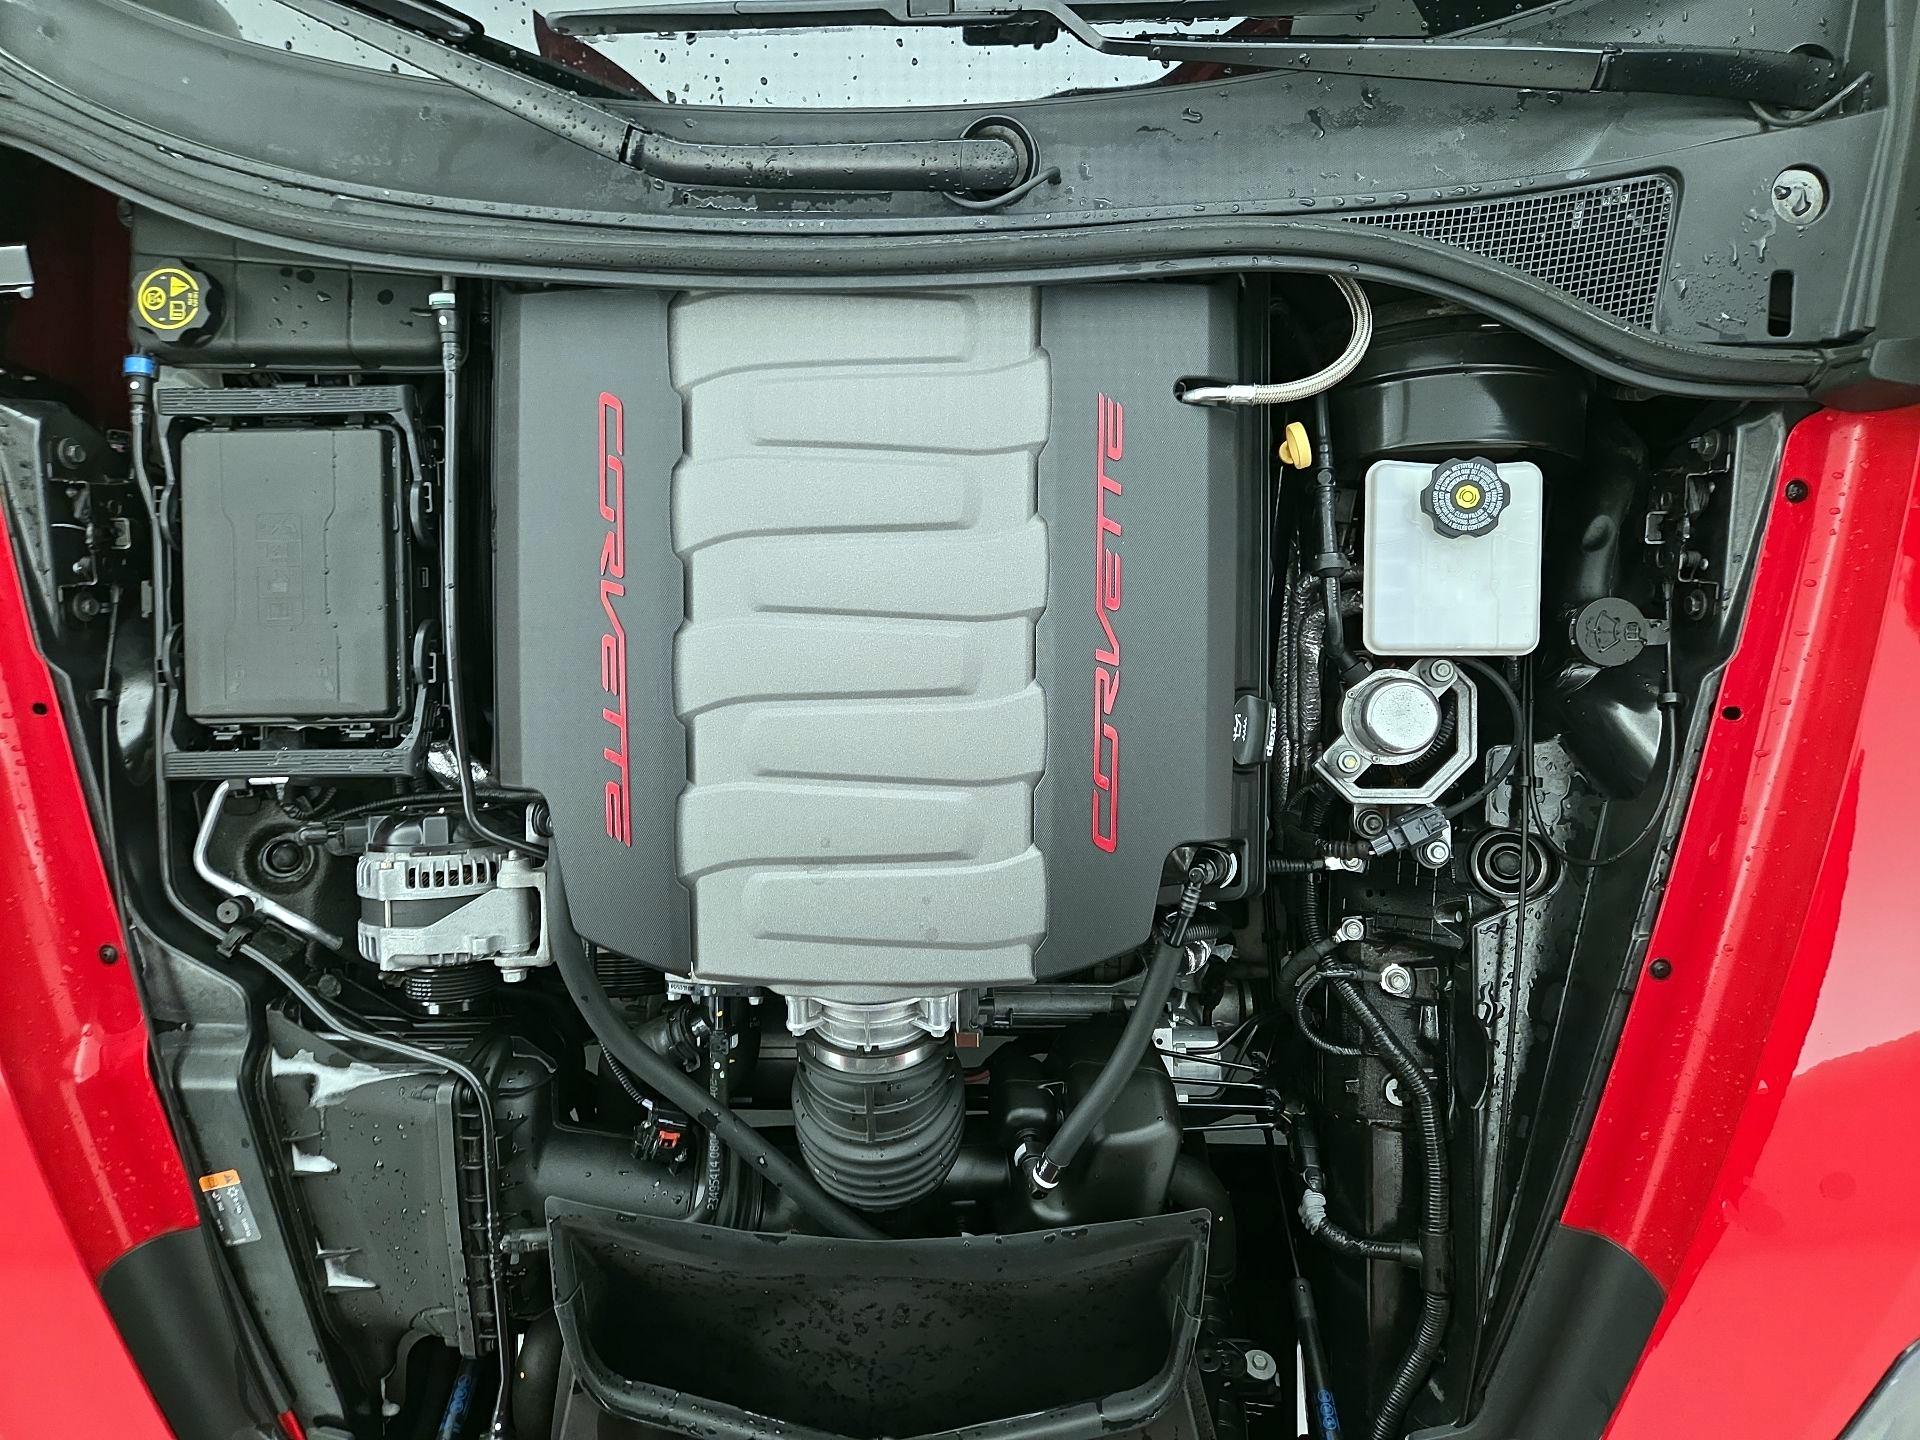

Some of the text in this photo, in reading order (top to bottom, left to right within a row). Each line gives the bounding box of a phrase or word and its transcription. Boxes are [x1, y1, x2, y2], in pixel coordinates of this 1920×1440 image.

[599, 393, 631, 847] CORVETTE
[1092, 393, 1124, 853] CORVETTE
[1266, 707, 1277, 757] dexos
[706, 1160, 720, 1210] 23495414
